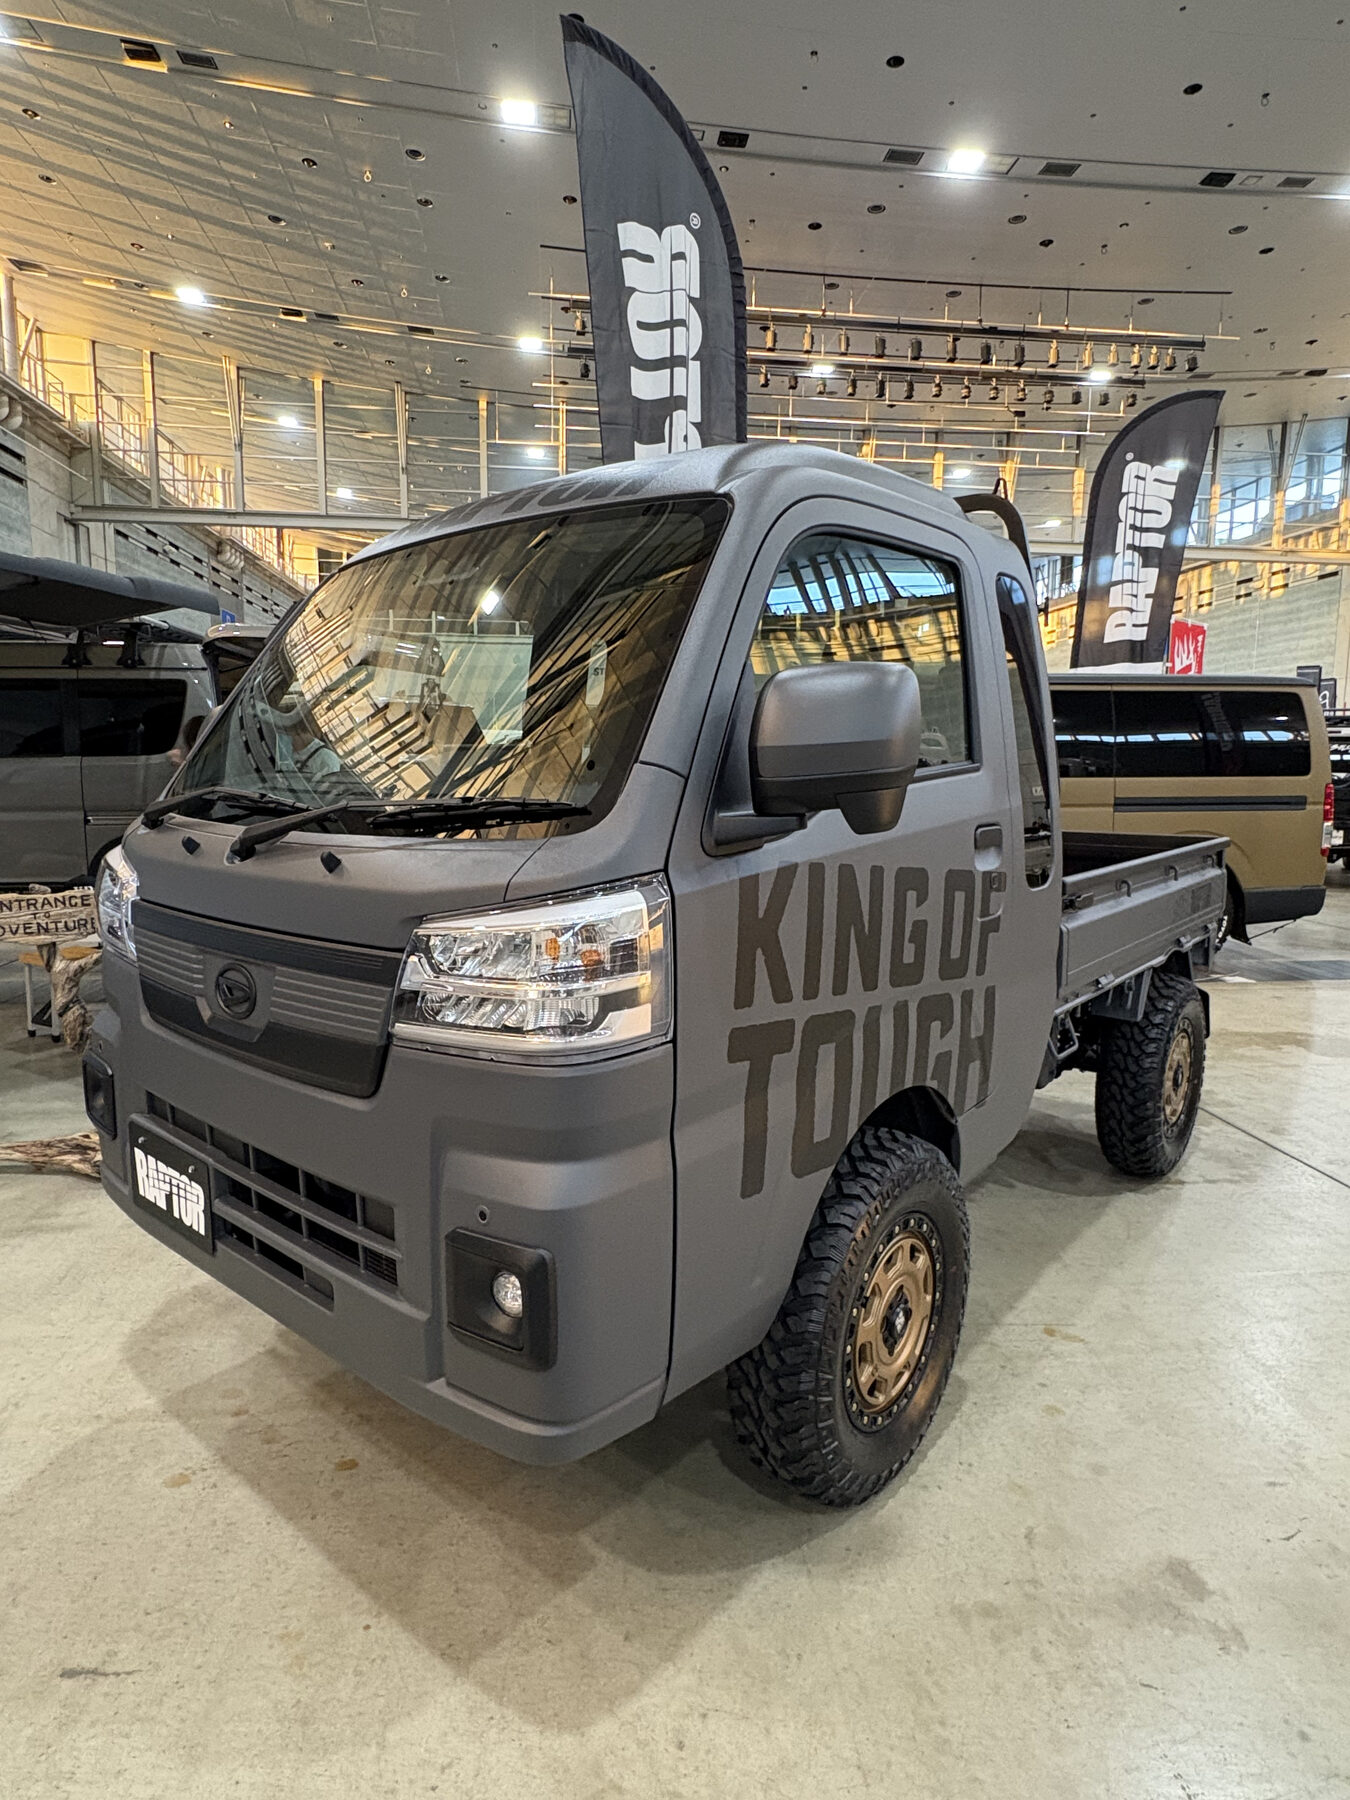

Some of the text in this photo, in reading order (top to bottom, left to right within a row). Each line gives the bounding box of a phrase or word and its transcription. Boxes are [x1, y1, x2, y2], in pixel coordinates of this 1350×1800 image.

[1103, 461, 1180, 643] RAPTOR
[31, 912, 51, 920] TO
[733, 861, 929, 1009] KING
[727, 985, 996, 1199] TOUGH
[134, 1147, 205, 1236] RAPTOR
